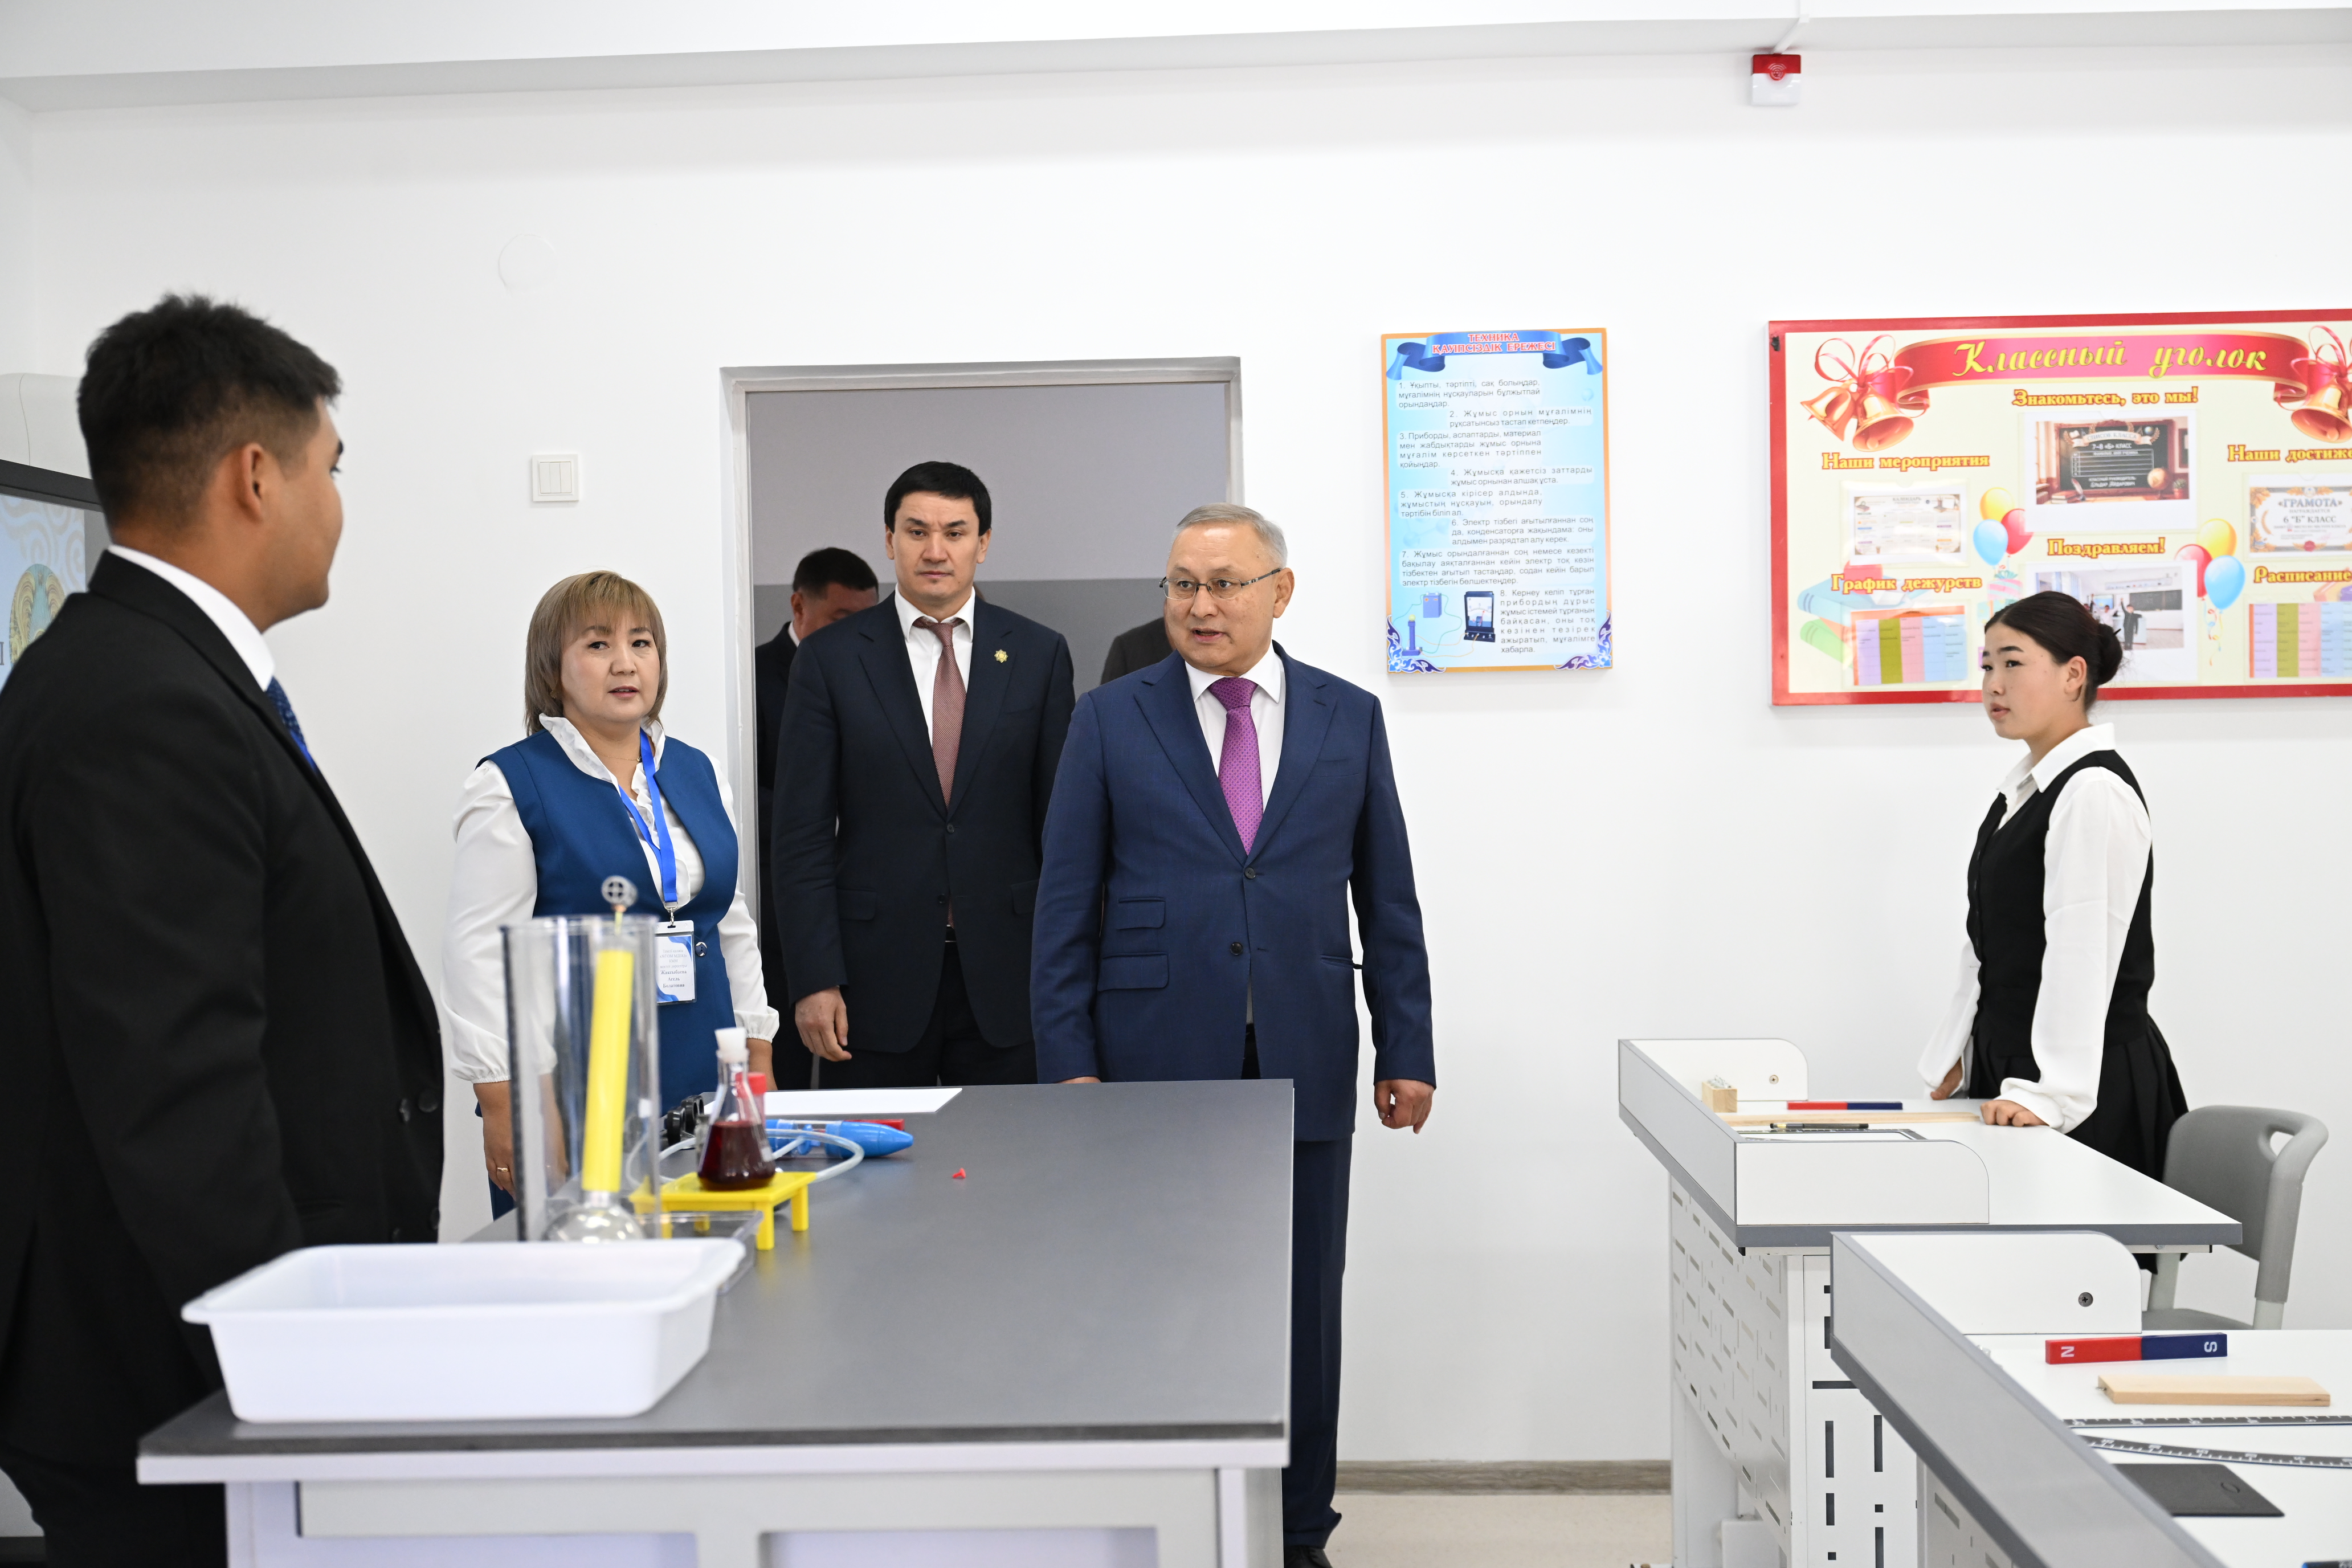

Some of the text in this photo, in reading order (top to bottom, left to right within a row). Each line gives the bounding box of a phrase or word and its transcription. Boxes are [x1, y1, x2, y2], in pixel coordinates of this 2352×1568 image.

[1468, 333, 1520, 342] ТЕХНИКА
[1432, 342, 1555, 355] ҚАУІПСІЗДІК ЕРЕЖЕСІ
[1951, 340, 2267, 379] Классный уголок
[1399, 391, 1441, 399] мұғалімнің
[1497, 388, 1540, 397] бұлжытпай
[2012, 386, 2198, 407] Знакомьтесь, это мы!
[1464, 410, 1497, 418] Жұмыс
[1420, 441, 1475, 450] жабдықтарды
[1400, 451, 1437, 460] мұғалім
[1496, 448, 1541, 458] тәртіппен
[2227, 444, 2280, 462] Наши
[1822, 452, 1990, 472] Наши мероприятия
[1414, 491, 1456, 499] Жұмысқа
[1461, 489, 1493, 498] кірісер
[2278, 499, 2343, 508] «ГРАМОТА»
[1401, 509, 1431, 518] тәртібін
[1463, 518, 1490, 527] Электр
[2047, 537, 2166, 559] Поздравляем!
[1414, 550, 1443, 559] Жұмыс
[1447, 550, 1509, 558] орындалғаннан
[2253, 566, 2352, 583] Расписание
[1831, 573, 1983, 594] График дежурств
[1512, 589, 1540, 598] Кернеу
[1500, 598, 1558, 607] прибордың
[1501, 646, 1535, 654] хабарла.
[2204, 1341, 2217, 1353] S
